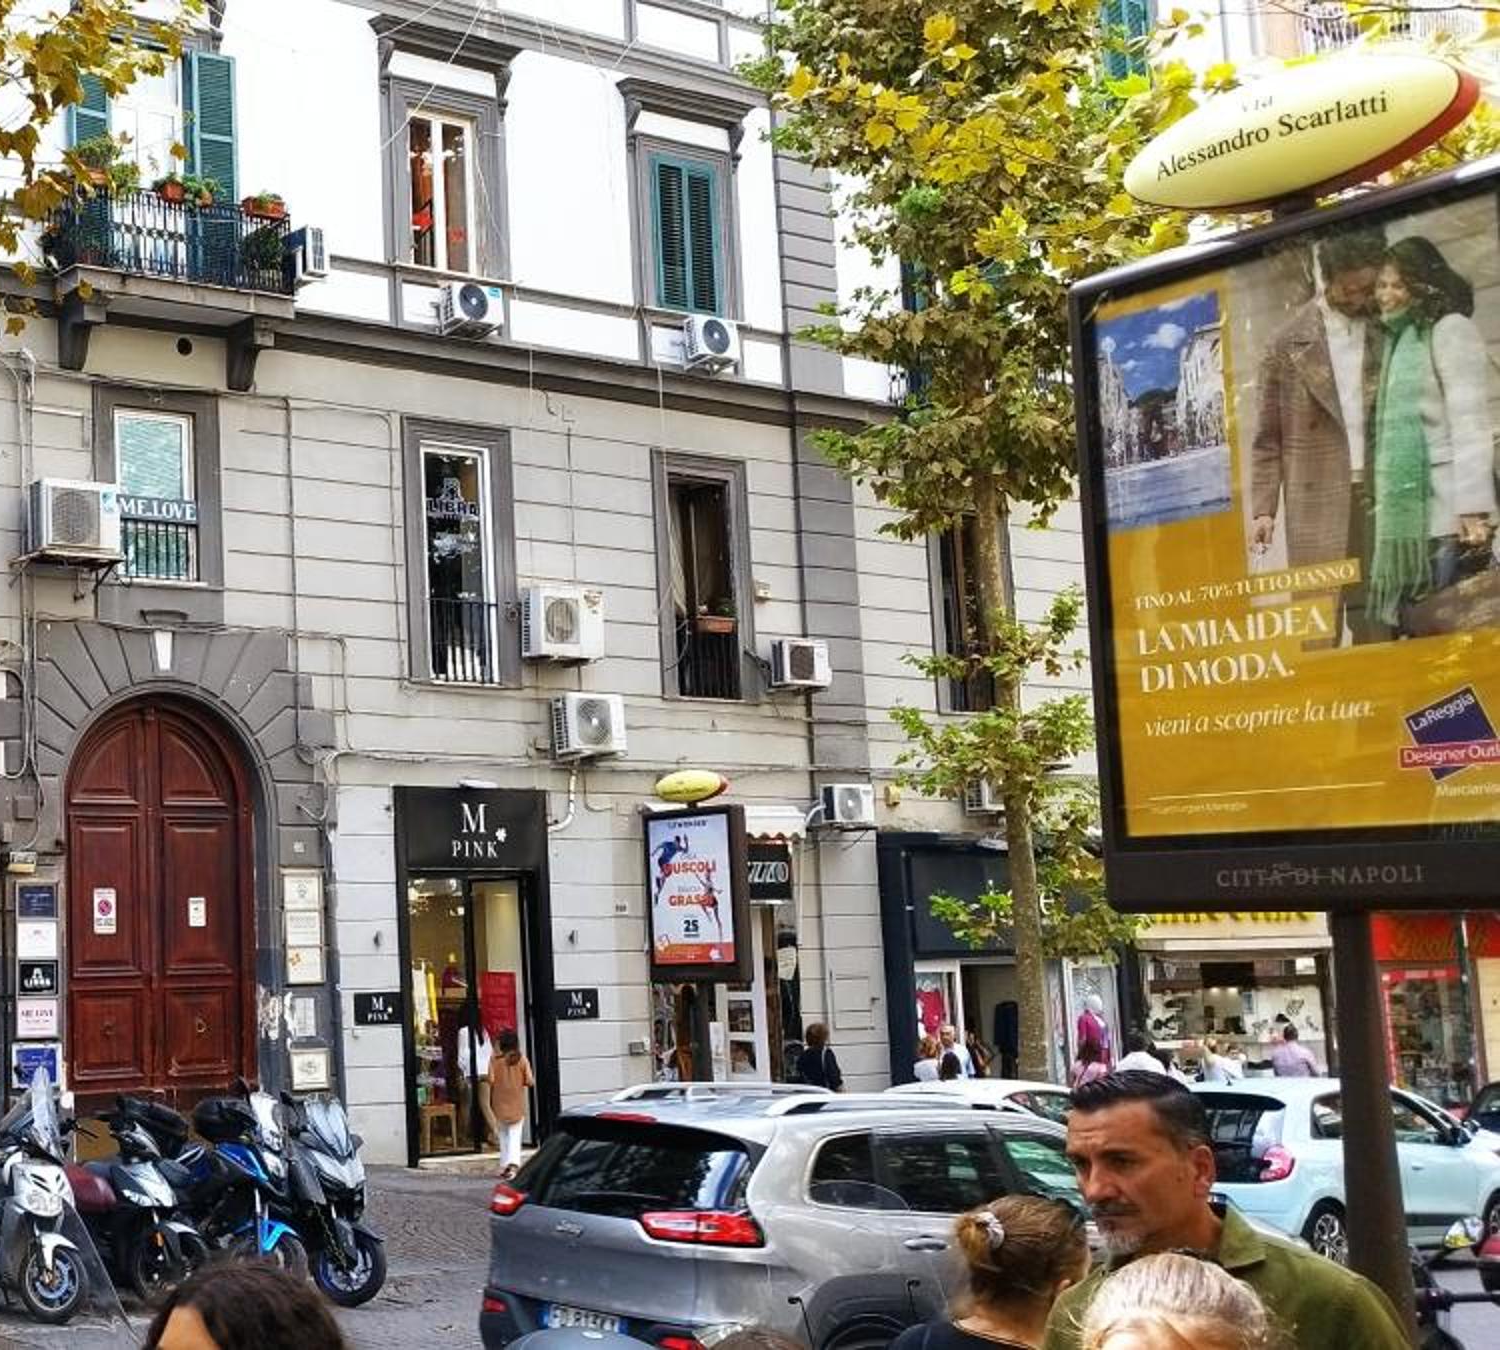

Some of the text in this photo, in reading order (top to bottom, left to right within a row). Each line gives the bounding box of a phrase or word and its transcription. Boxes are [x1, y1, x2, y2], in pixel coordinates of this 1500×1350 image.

[1157, 91, 1388, 181] Alessandro Scarlatti
[1135, 594, 1173, 611] FINO
[1172, 590, 1194, 605] AL
[1235, 574, 1291, 596] TUTTO
[1138, 605, 1328, 656] LA MIA IDEA
[1141, 650, 1296, 693] DI MODA.
[1145, 713, 1191, 736] vieni
[1194, 715, 1208, 732] a
[1213, 703, 1300, 733] scoprire
[1303, 698, 1324, 722] la
[1403, 749, 1467, 765] Designer
[461, 803, 488, 833] M
[452, 841, 498, 858] PINK
[1295, 869, 1320, 885] DI
[1331, 865, 1424, 885] NAPOLI
[684, 919, 699, 932] 25
[371, 996, 384, 1011] M
[571, 992, 583, 1006] M
